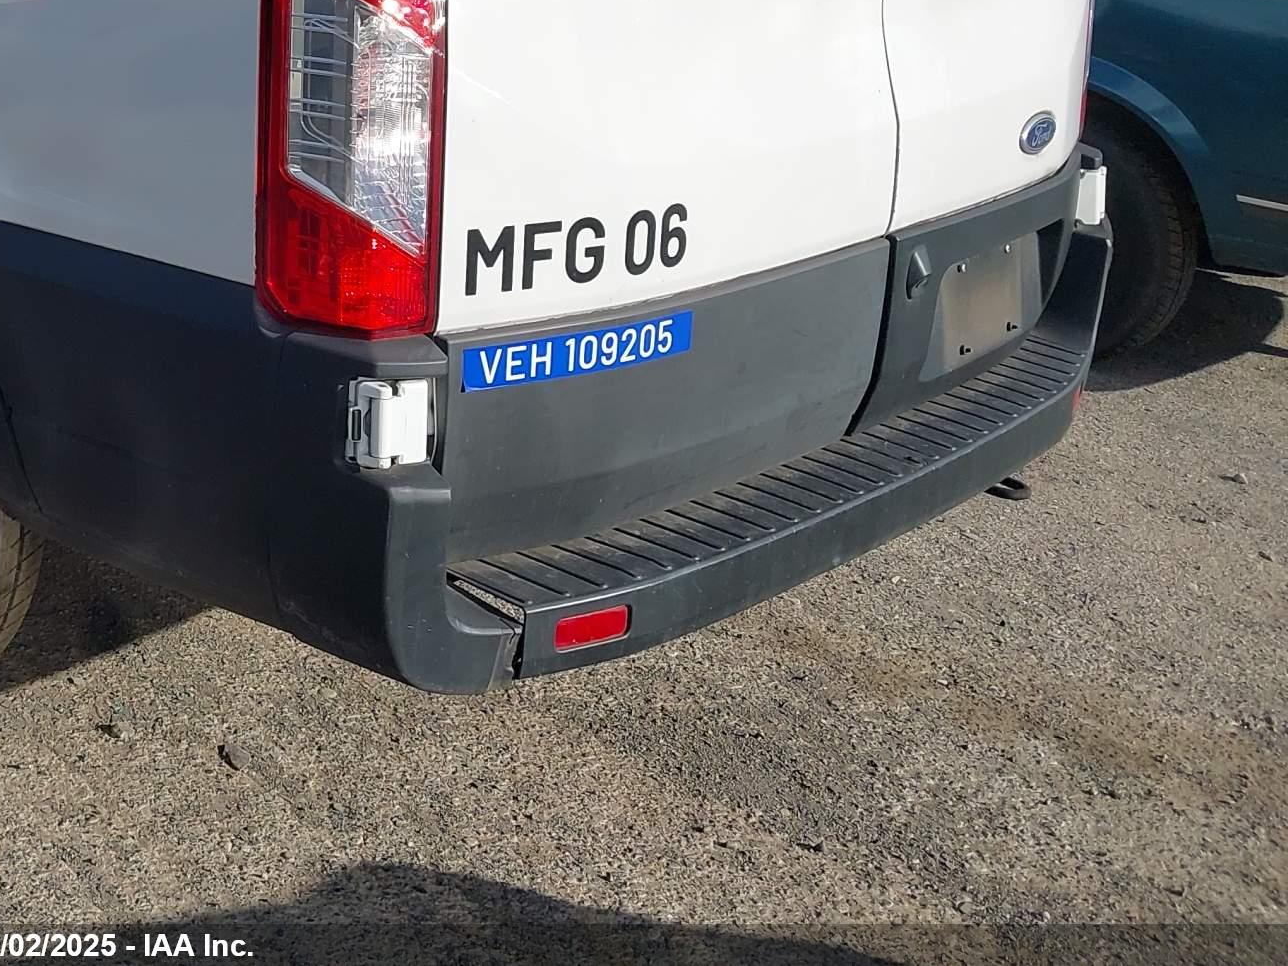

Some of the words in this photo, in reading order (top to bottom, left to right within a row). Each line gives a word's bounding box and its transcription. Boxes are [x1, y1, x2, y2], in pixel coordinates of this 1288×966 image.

[465, 217, 606, 296] MFG
[624, 202, 688, 276] 06
[479, 341, 553, 385] VEH
[564, 319, 673, 372] 109205
